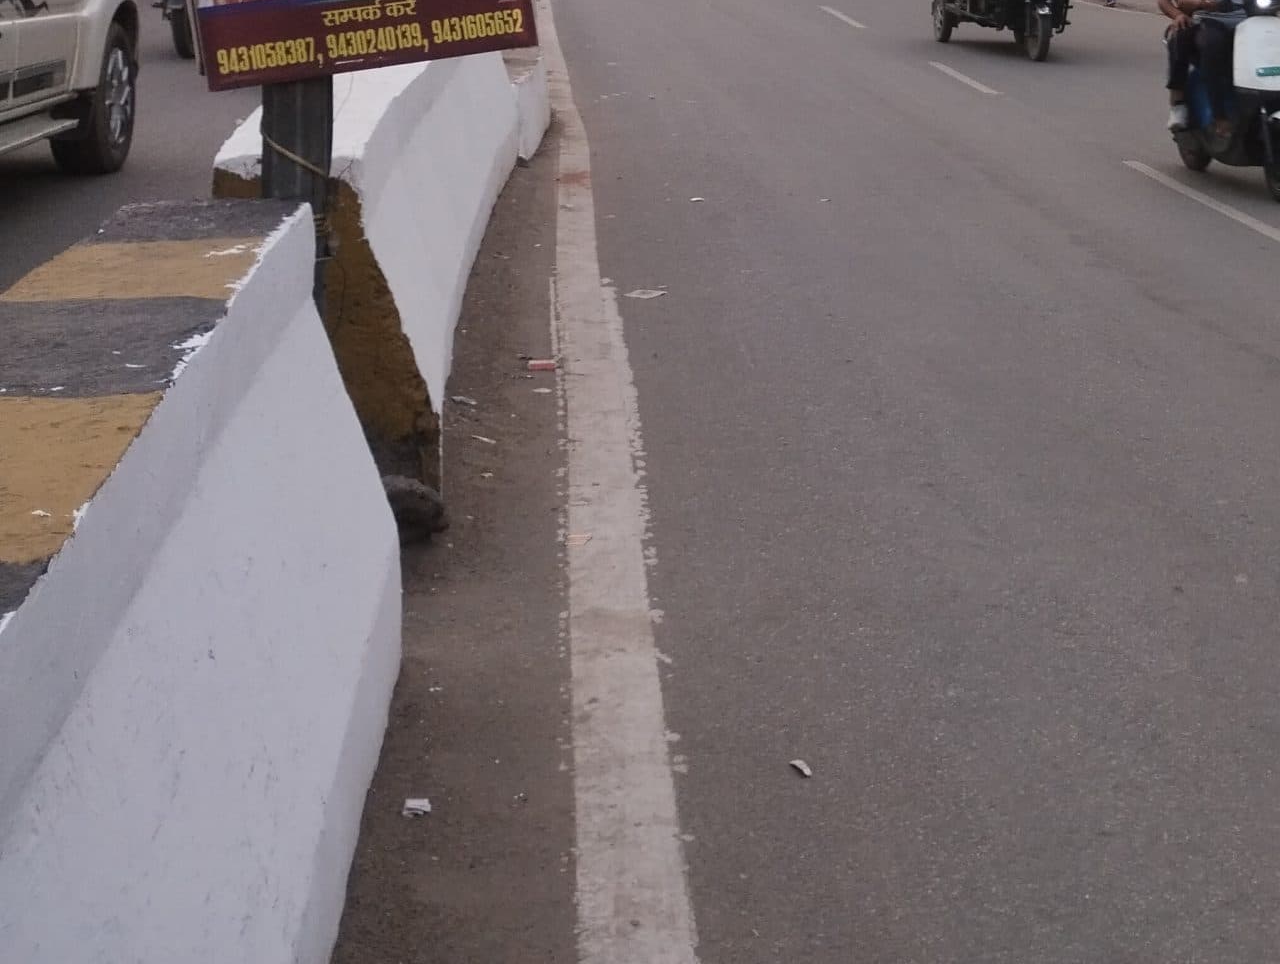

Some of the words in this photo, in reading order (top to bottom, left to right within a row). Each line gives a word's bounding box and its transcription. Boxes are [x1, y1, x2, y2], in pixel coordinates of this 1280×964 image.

[216, 37, 324, 76] 9431058387,
[325, 23, 430, 59] 9430240139,
[430, 8, 524, 45] 9431605652
